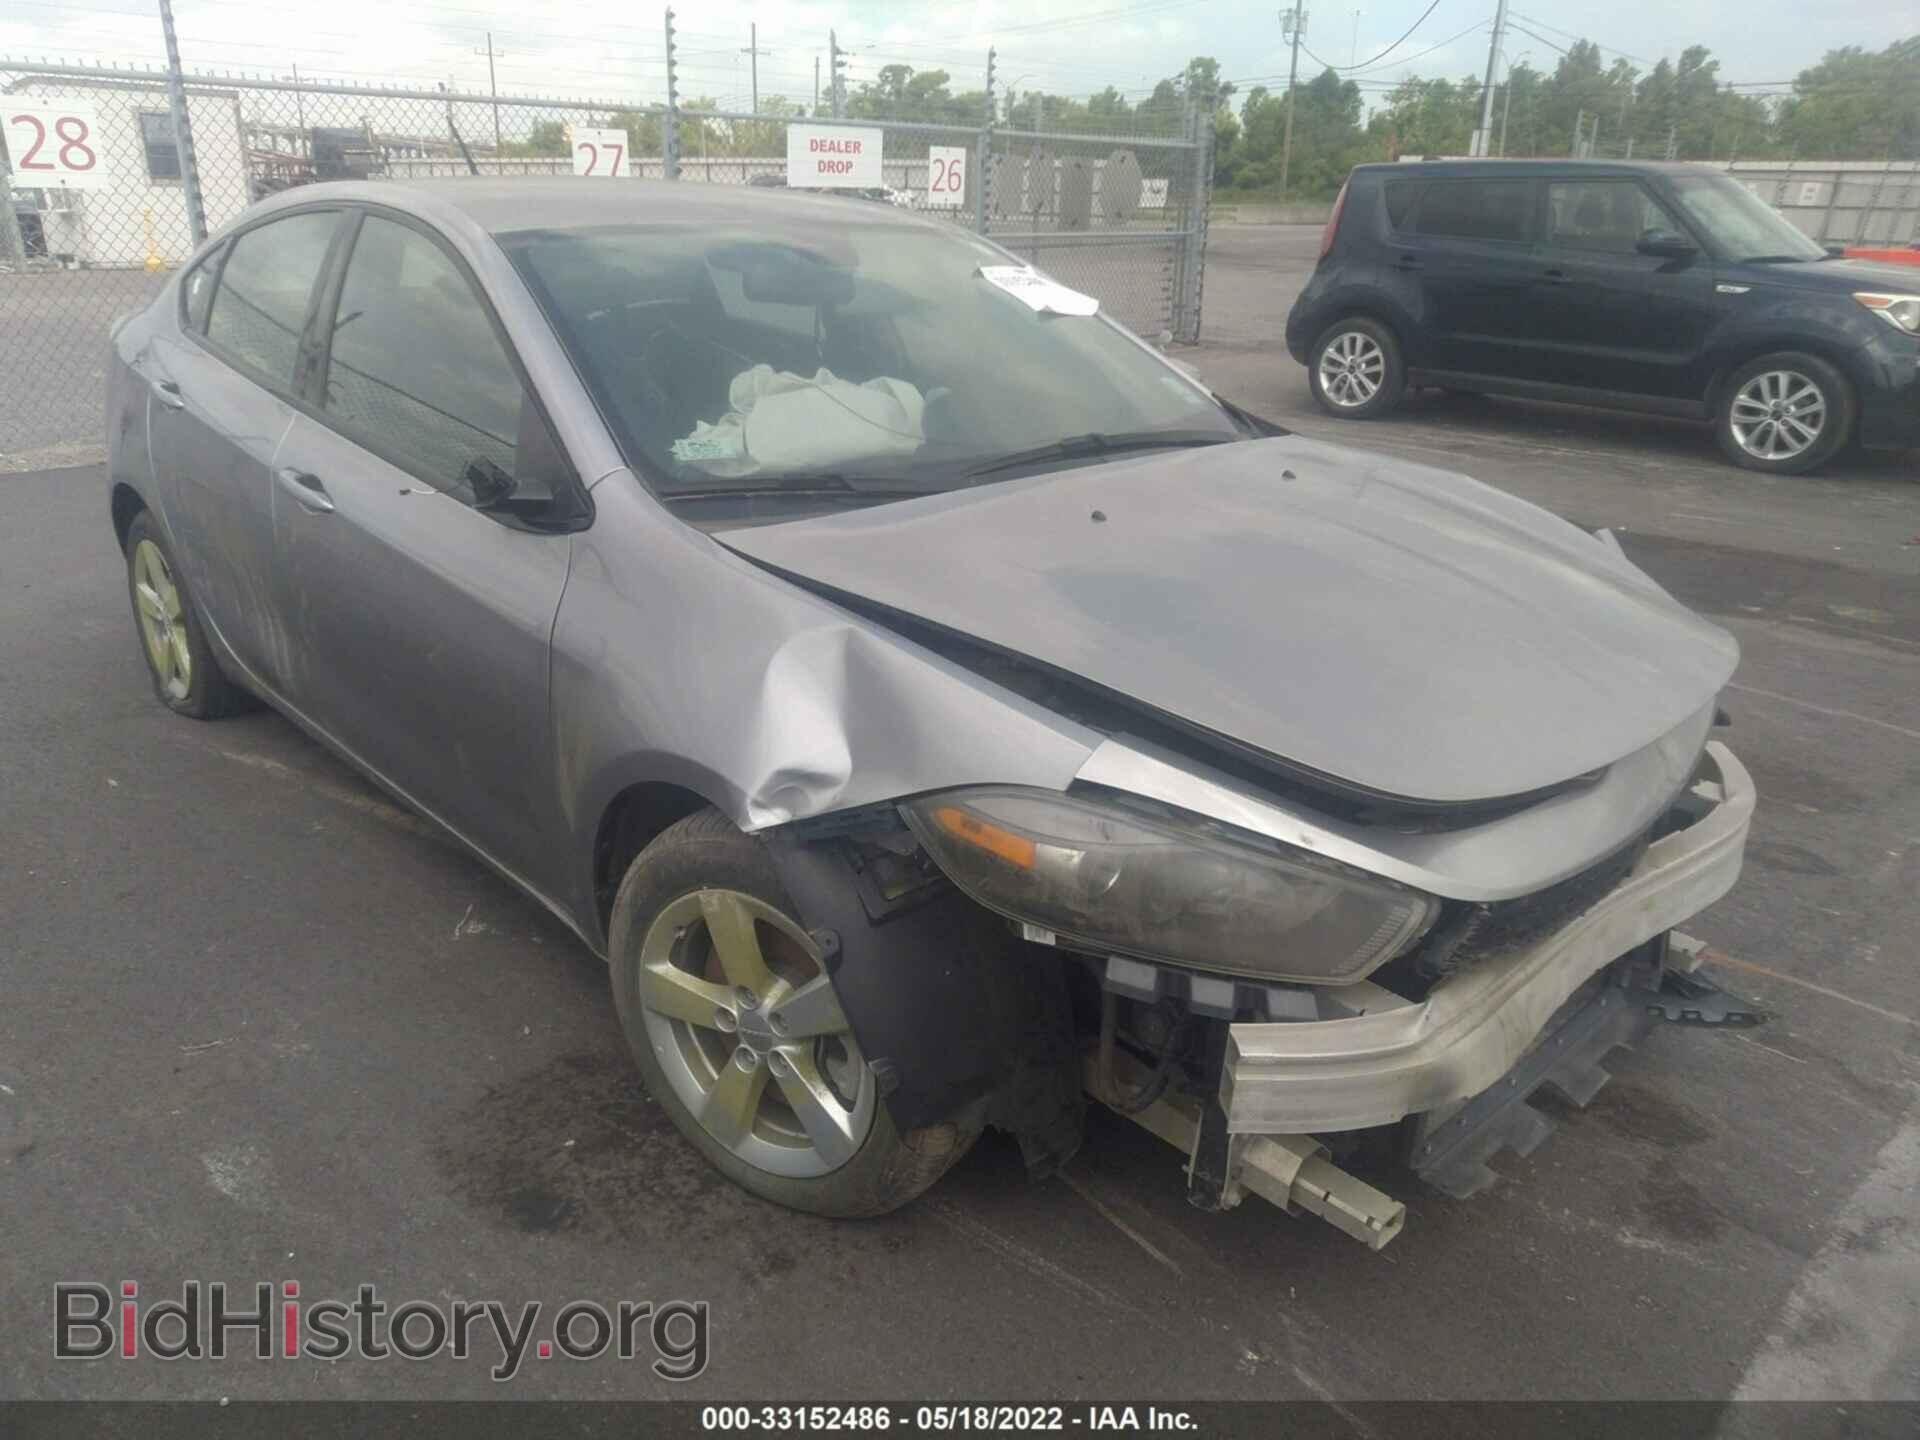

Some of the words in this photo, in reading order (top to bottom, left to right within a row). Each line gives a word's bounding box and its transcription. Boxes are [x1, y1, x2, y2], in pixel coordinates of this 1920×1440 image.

[11, 114, 97, 171] 28
[577, 142, 623, 177] 27
[809, 138, 862, 154] DEALER
[817, 159, 854, 174] DROP
[931, 158, 962, 193] 26
